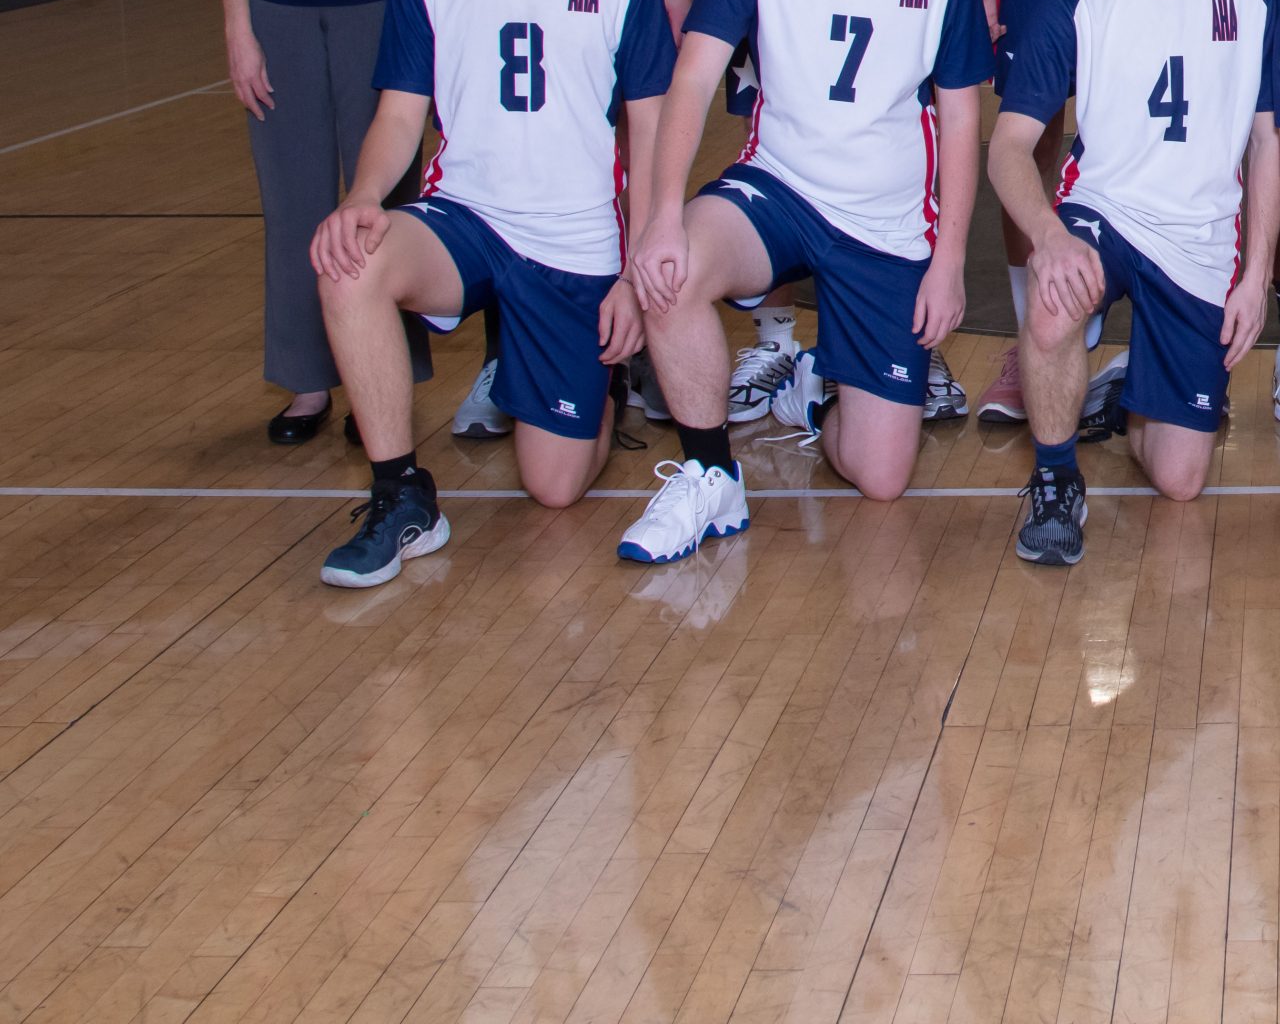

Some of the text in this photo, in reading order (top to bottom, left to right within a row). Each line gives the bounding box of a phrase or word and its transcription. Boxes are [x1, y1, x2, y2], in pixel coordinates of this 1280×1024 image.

[500, 23, 545, 112] 8
[829, 14, 873, 102] 7
[1148, 56, 1188, 142] 4
